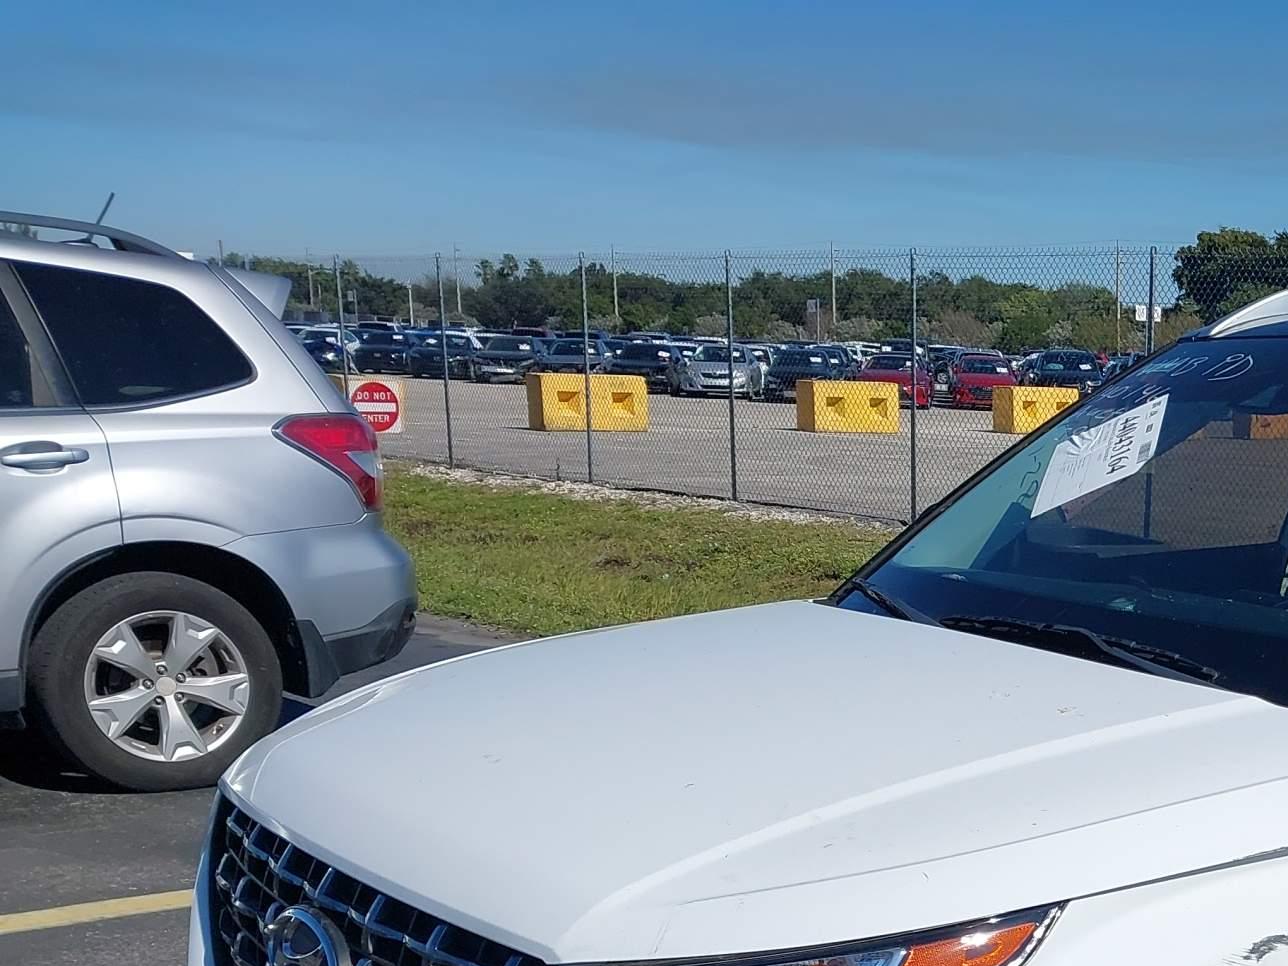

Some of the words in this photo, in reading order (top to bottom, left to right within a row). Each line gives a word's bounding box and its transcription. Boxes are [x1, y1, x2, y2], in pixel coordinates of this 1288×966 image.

[356, 391, 370, 400] DO
[373, 391, 391, 400] NOT
[1106, 415, 1141, 475] 44043164
